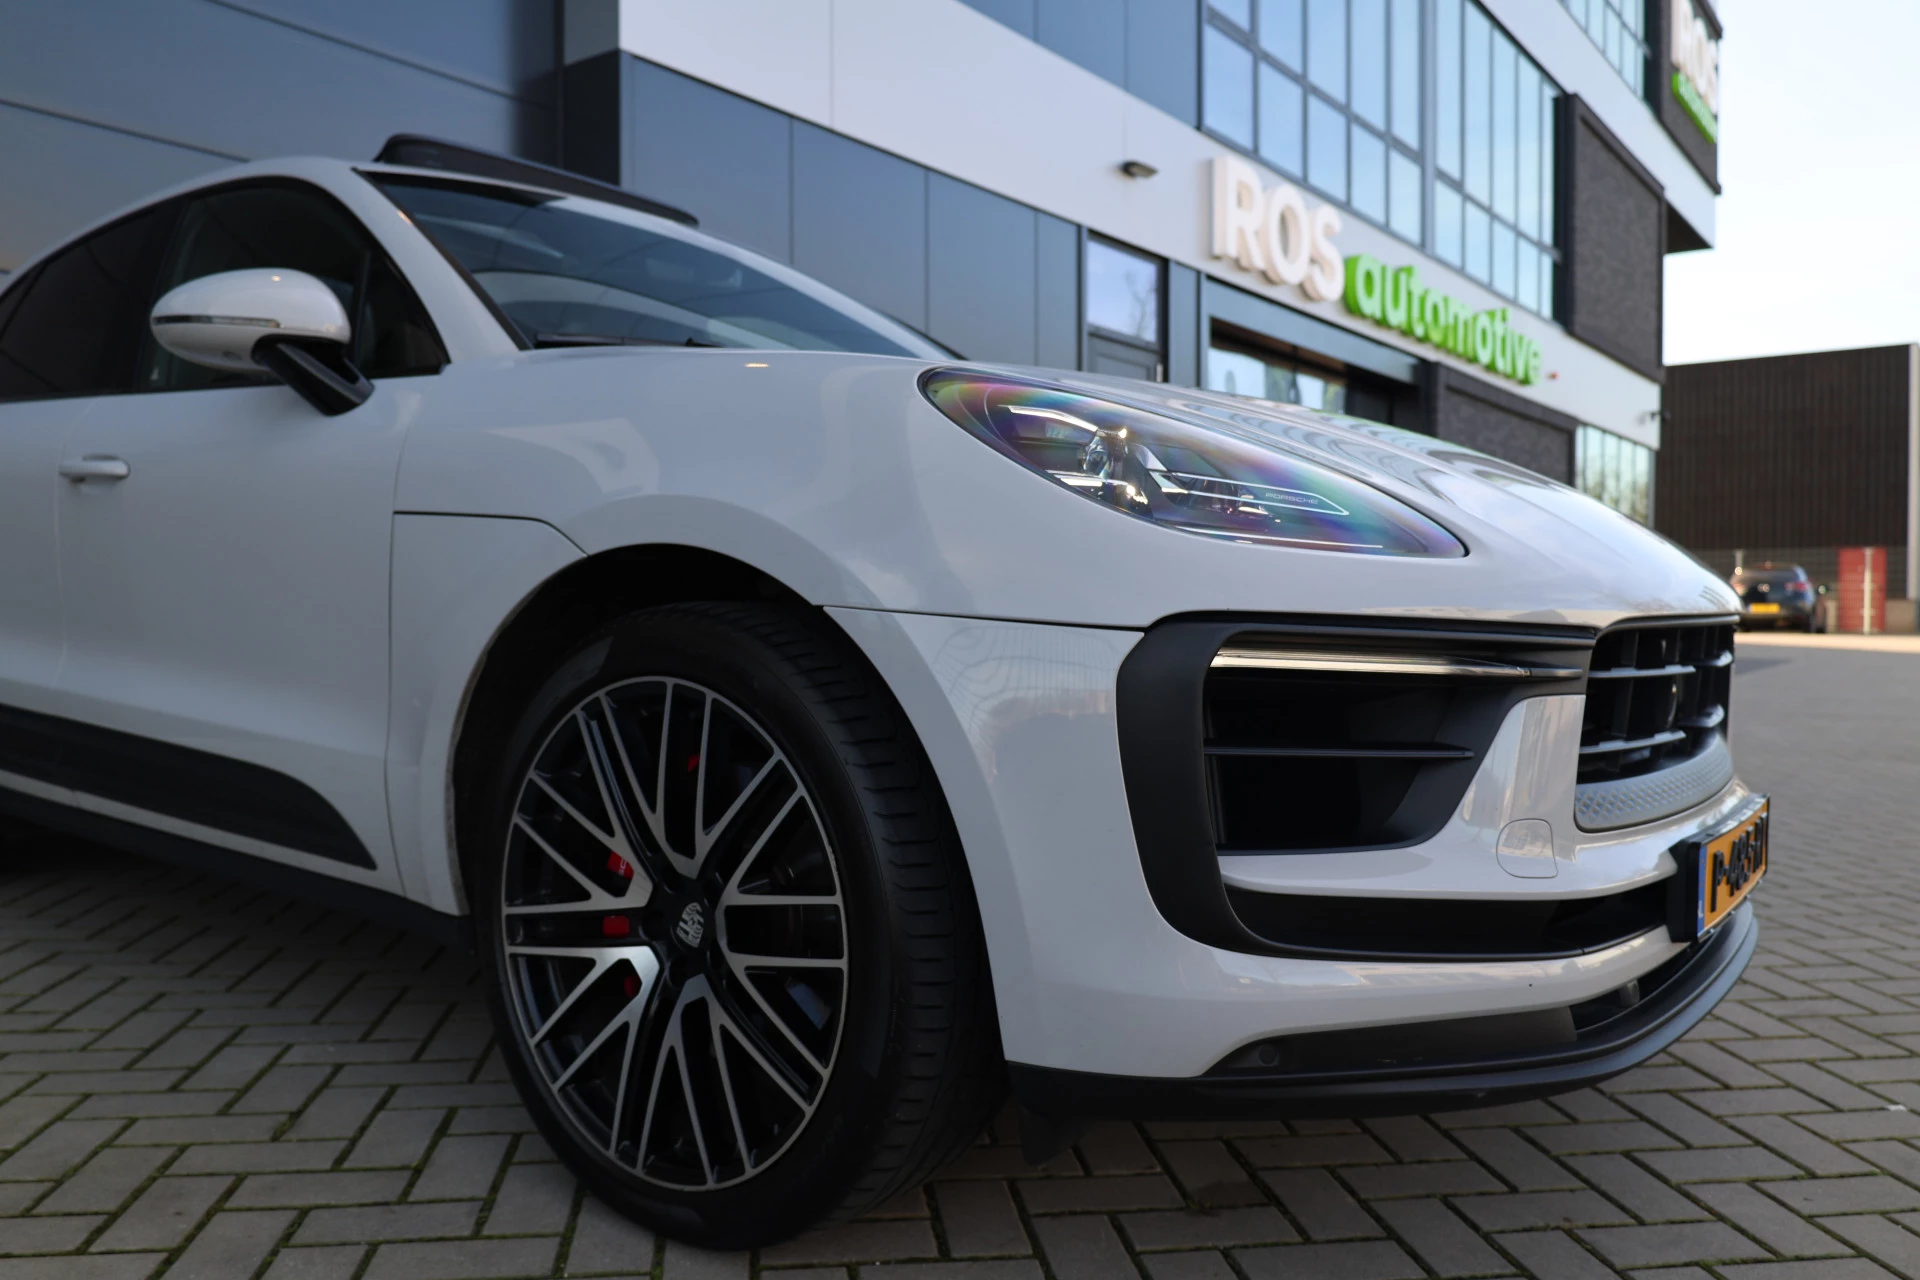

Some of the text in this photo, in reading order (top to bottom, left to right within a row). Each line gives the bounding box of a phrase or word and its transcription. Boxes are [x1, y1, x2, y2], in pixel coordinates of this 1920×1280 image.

[1212, 155, 1543, 386] ROS automotive
[1265, 491, 1319, 505] PORSCHE
